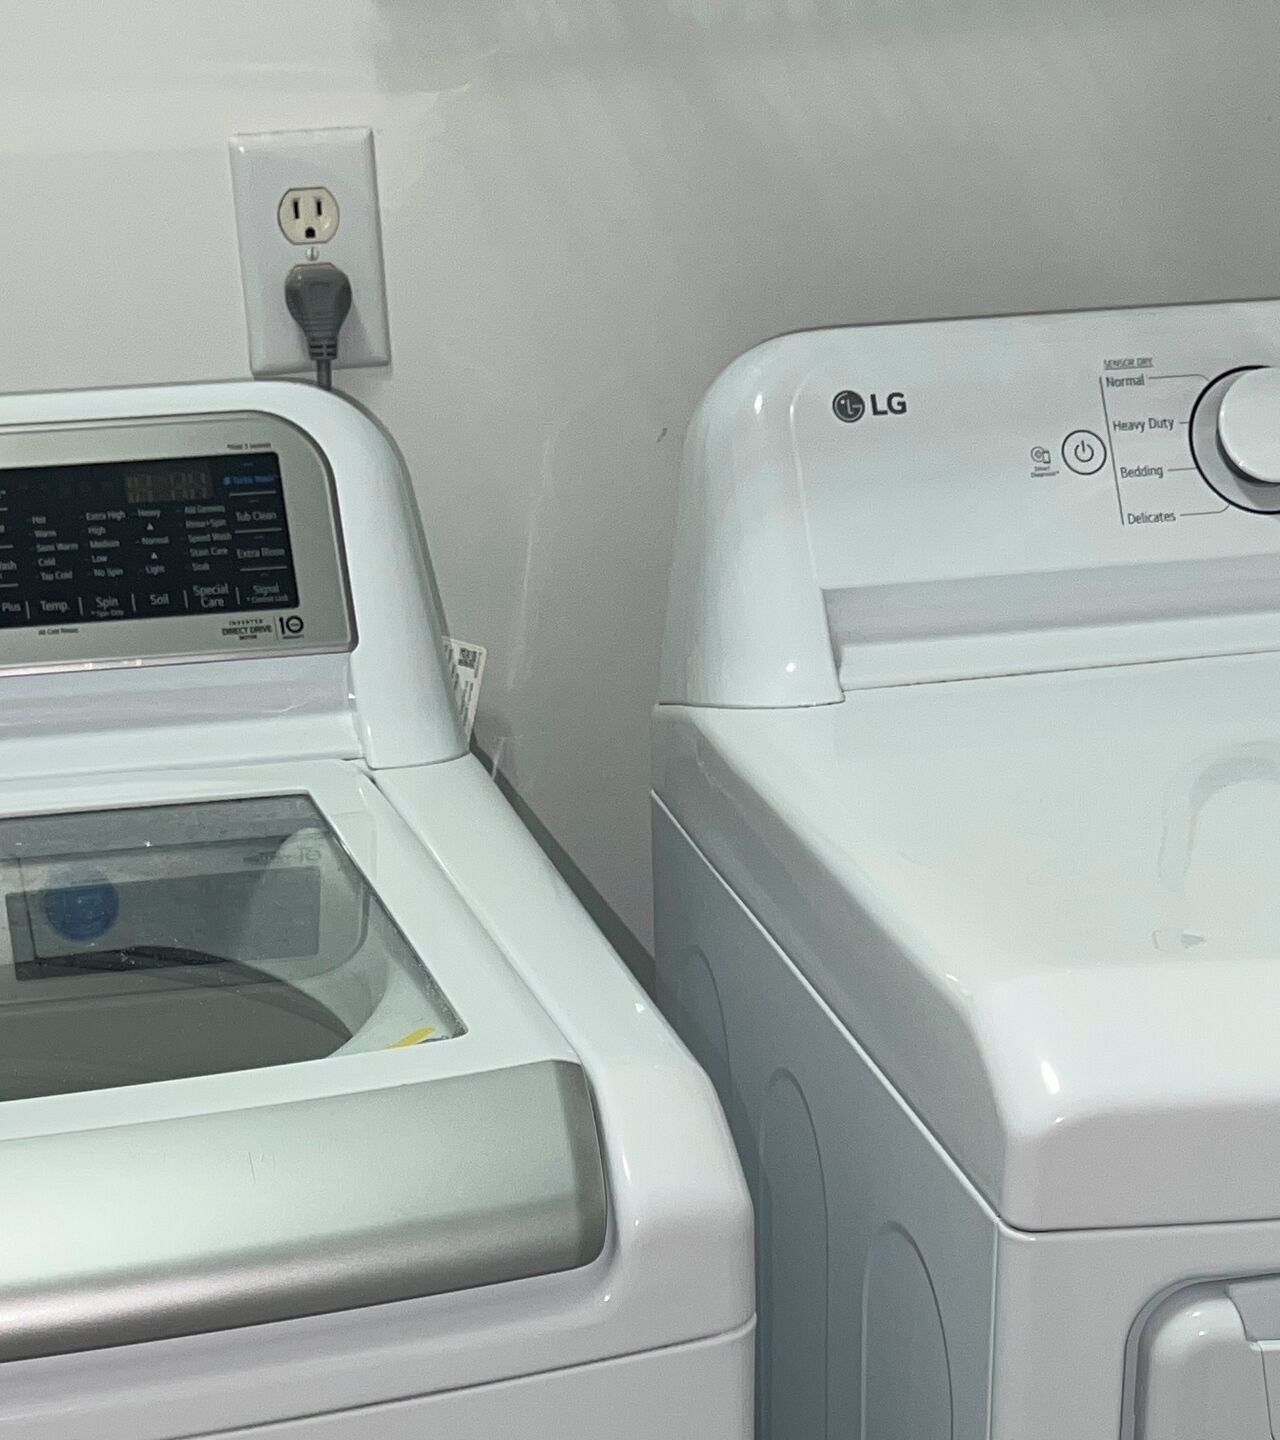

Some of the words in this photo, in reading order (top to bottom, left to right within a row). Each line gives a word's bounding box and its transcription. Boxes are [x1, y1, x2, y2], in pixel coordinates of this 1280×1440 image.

[1137, 357, 1153, 368] DRY
[1106, 373, 1145, 388] Normal
[1112, 420, 1145, 433] Heavy
[1148, 418, 1174, 431] Duty
[1120, 466, 1163, 479] Bedding
[236, 512, 250, 522] Tub
[252, 510, 277, 521] Clean
[1128, 512, 1176, 525] Delicates
[193, 583, 229, 597] Special
[253, 582, 279, 595] Signal
[96, 596, 119, 609] Spin
[150, 593, 169, 606] Soil
[201, 597, 224, 609] Care
[2, 601, 21, 612] Plus
[222, 626, 248, 636] DIRECT
[249, 625, 272, 634] DRIVE
[279, 615, 304, 635] 10
